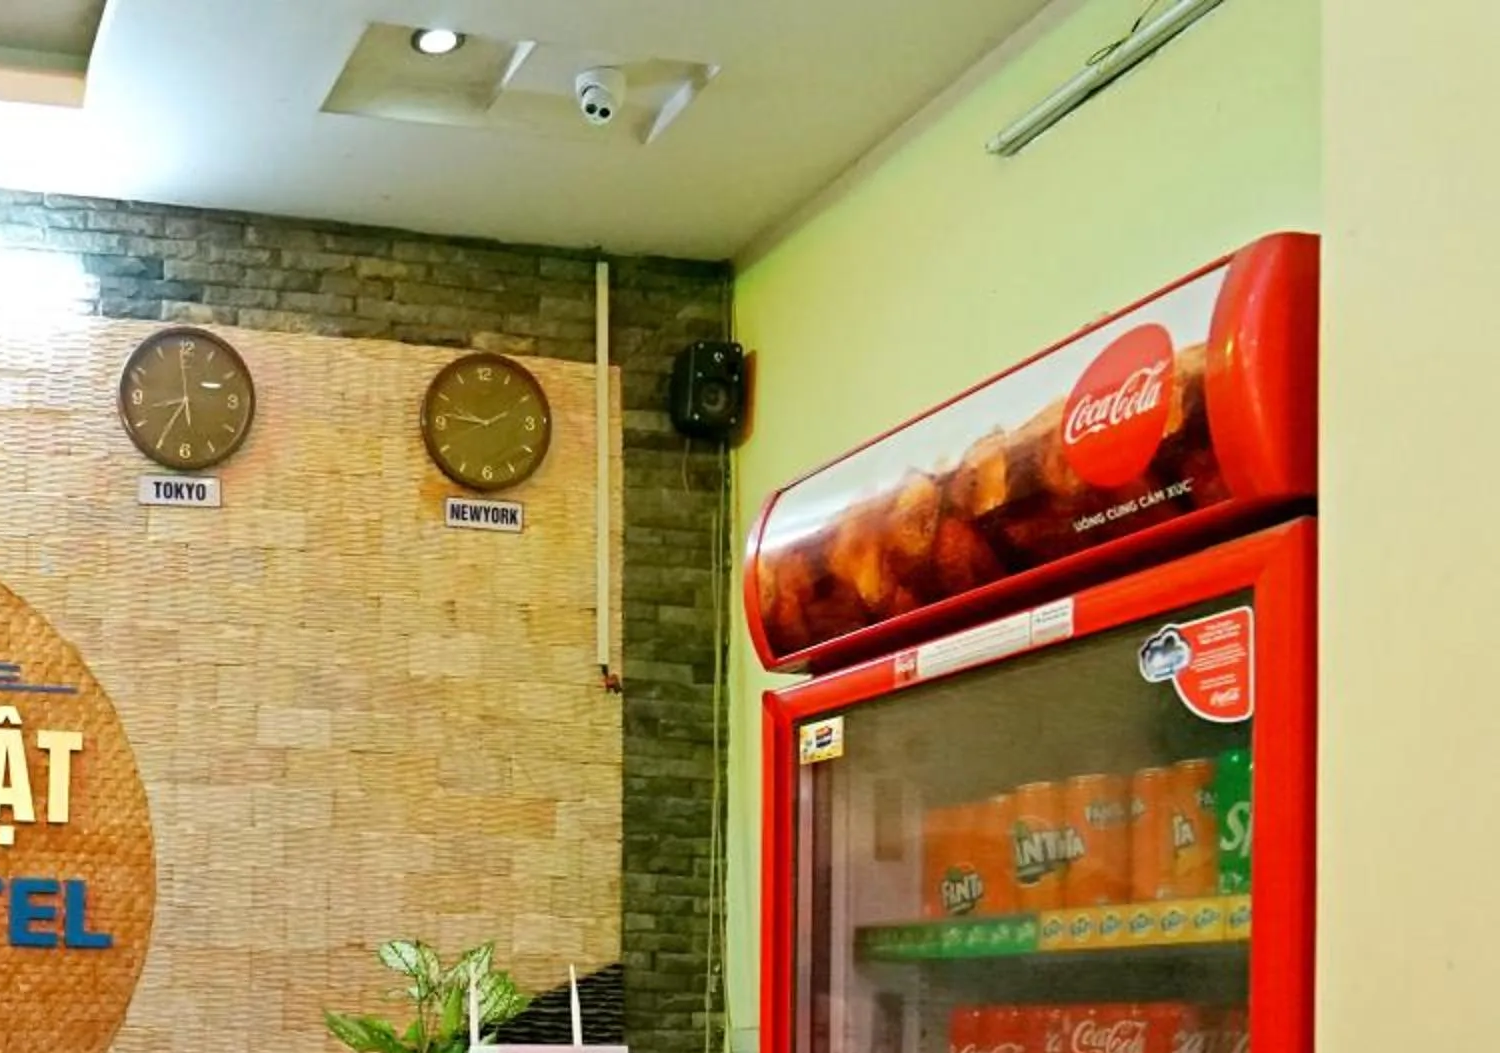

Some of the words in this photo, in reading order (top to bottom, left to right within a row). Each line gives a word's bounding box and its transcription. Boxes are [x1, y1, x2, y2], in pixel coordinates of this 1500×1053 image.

[476, 367, 493, 381] 12
[132, 389, 143, 405] 9
[227, 394, 239, 410] 3
[525, 416, 535, 431] 3
[179, 443, 191, 459] 6
[482, 465, 493, 481] 6
[154, 481, 207, 501] TOKYO
[450, 503, 519, 525] NEWYORK
